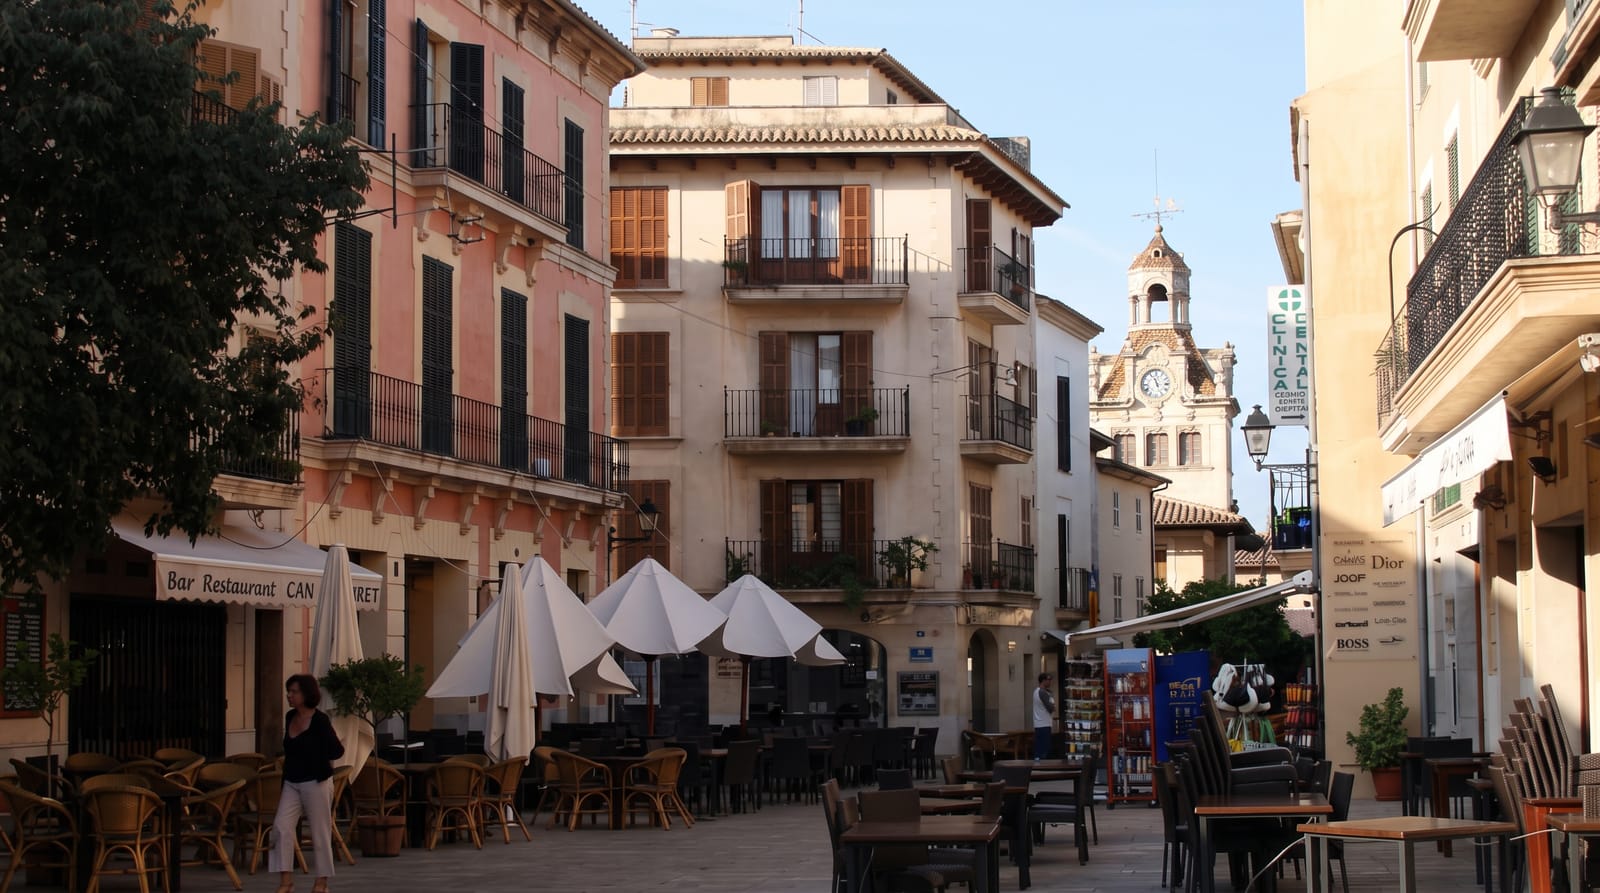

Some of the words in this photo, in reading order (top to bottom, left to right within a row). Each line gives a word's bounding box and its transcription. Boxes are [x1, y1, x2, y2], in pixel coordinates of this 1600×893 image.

[1271, 314, 1288, 390] CLINICA
[1372, 554, 1405, 569] Dior
[167, 570, 195, 591] Bar
[202, 574, 276, 597] Restaurant
[286, 581, 315, 600] CAN
[1334, 573, 1366, 583] JOOF
[1337, 638, 1369, 649] BOSS
